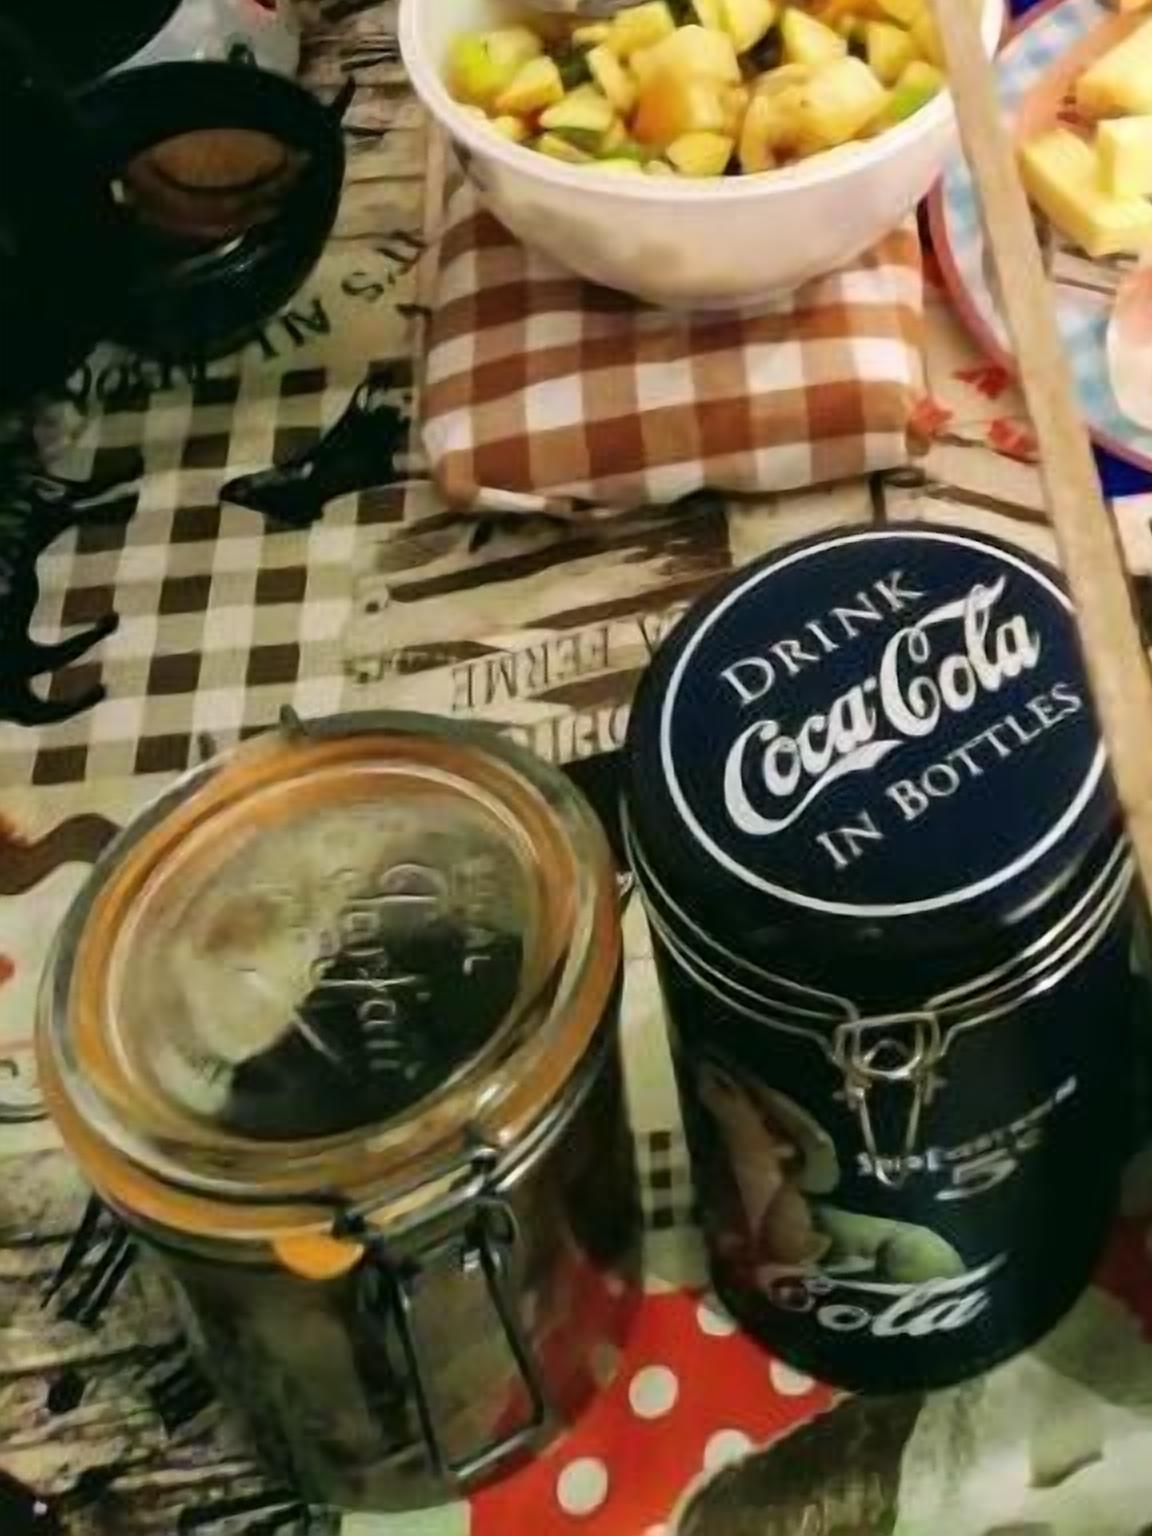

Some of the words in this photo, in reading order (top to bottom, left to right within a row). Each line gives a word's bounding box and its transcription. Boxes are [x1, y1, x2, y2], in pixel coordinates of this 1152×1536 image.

[452, 626, 609, 711] FERME
[720, 570, 926, 706] DRINK
[724, 575, 1041, 836] Coca-Cola
[816, 810, 884, 869] IN
[886, 682, 1083, 822] BOTTLES
